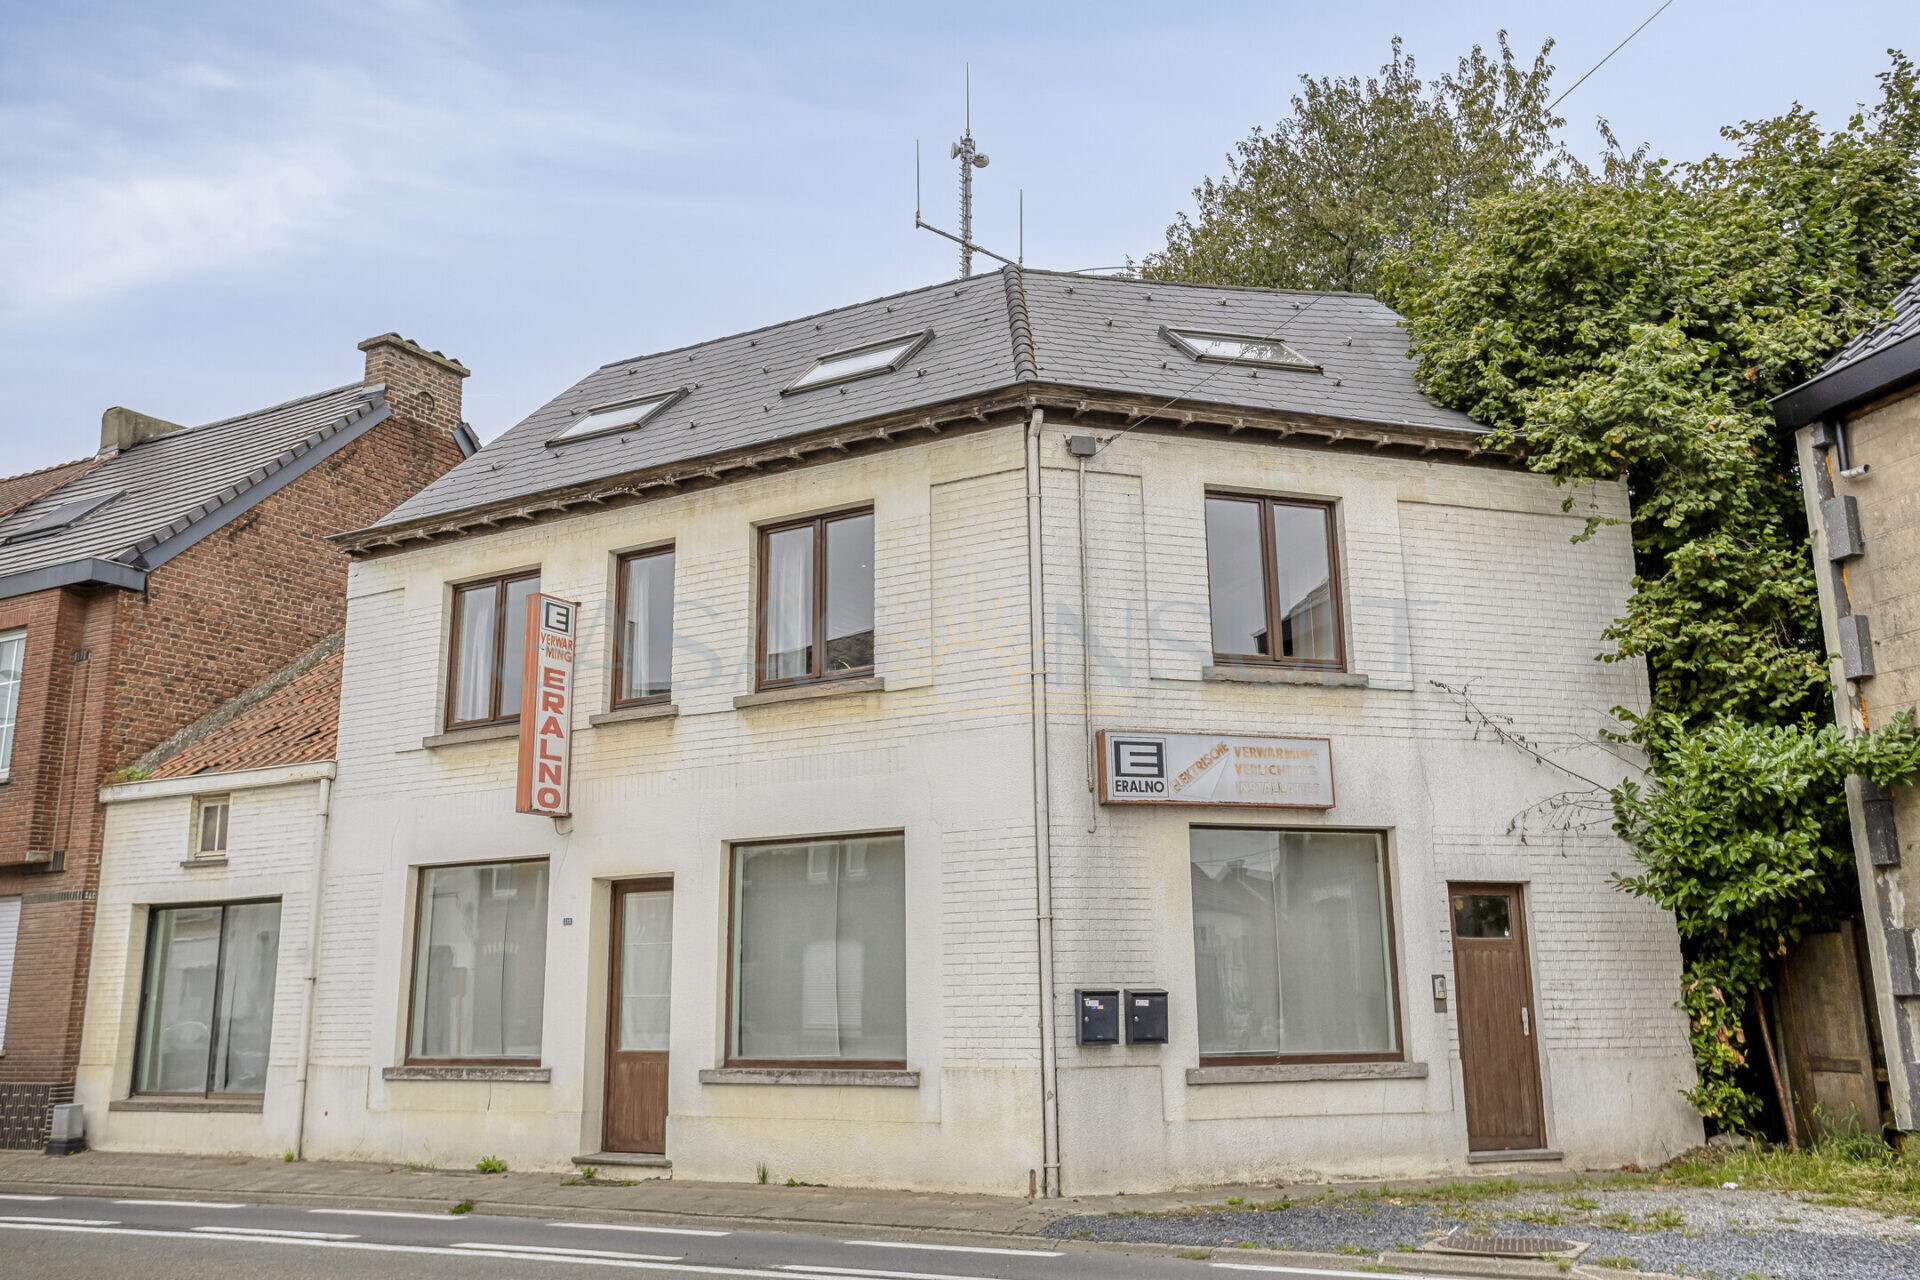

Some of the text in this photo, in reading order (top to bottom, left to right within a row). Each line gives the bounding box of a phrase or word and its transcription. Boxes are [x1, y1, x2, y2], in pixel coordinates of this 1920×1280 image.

[541, 631, 573, 651] VERWAR
[537, 667, 566, 809] ERALNO
[1115, 779, 1165, 794] ERALNO
